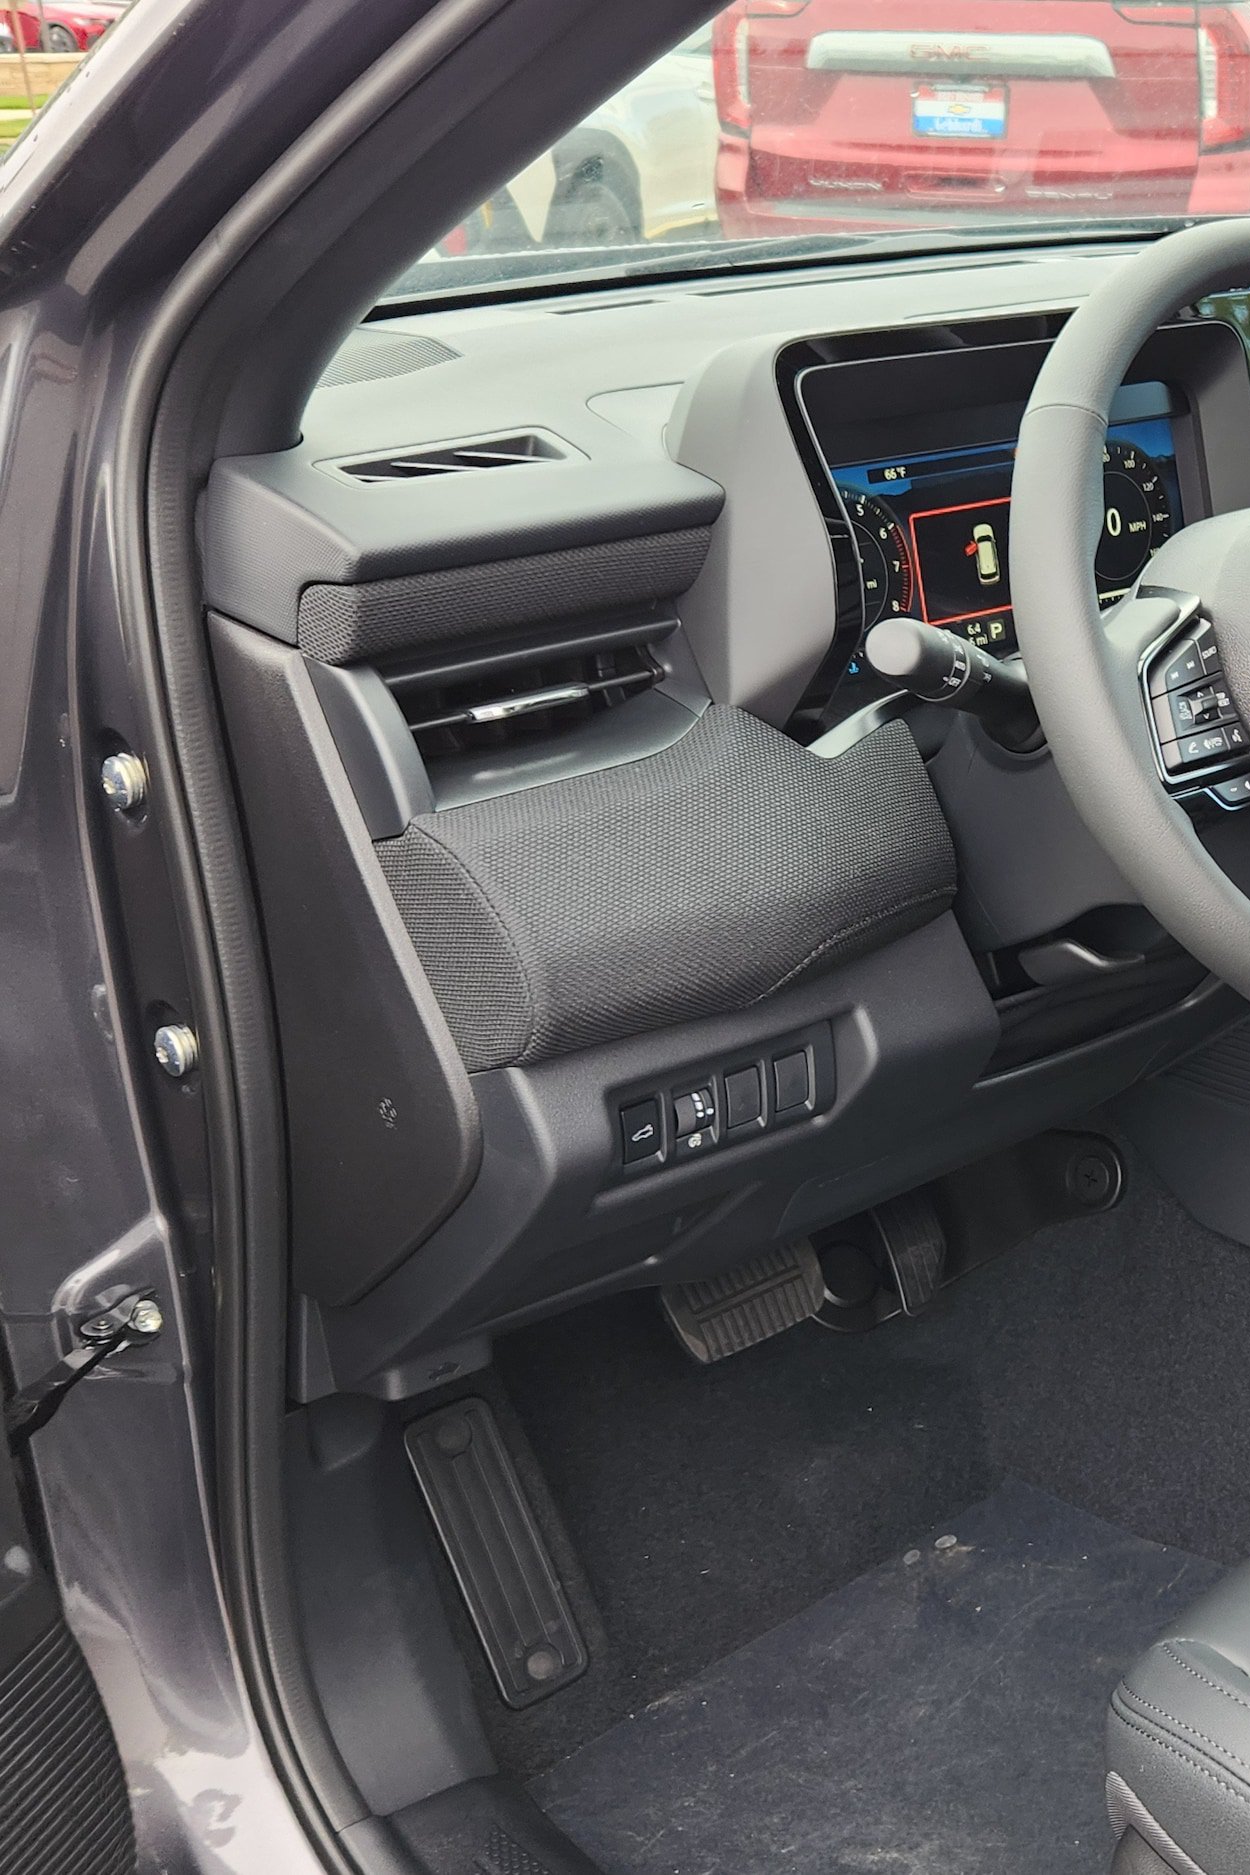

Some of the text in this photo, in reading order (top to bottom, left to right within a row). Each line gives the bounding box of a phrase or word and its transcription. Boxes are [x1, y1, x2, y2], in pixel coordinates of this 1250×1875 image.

[910, 43, 992, 62] GMC
[1124, 459, 1136, 469] 100
[1142, 482, 1155, 492] 120
[856, 503, 865, 517] 5
[1106, 507, 1147, 537] 0 MPH
[879, 527, 888, 539] 6
[892, 560, 900, 573] 7
[891, 600, 900, 613] 8
[989, 622, 1003, 639] P
